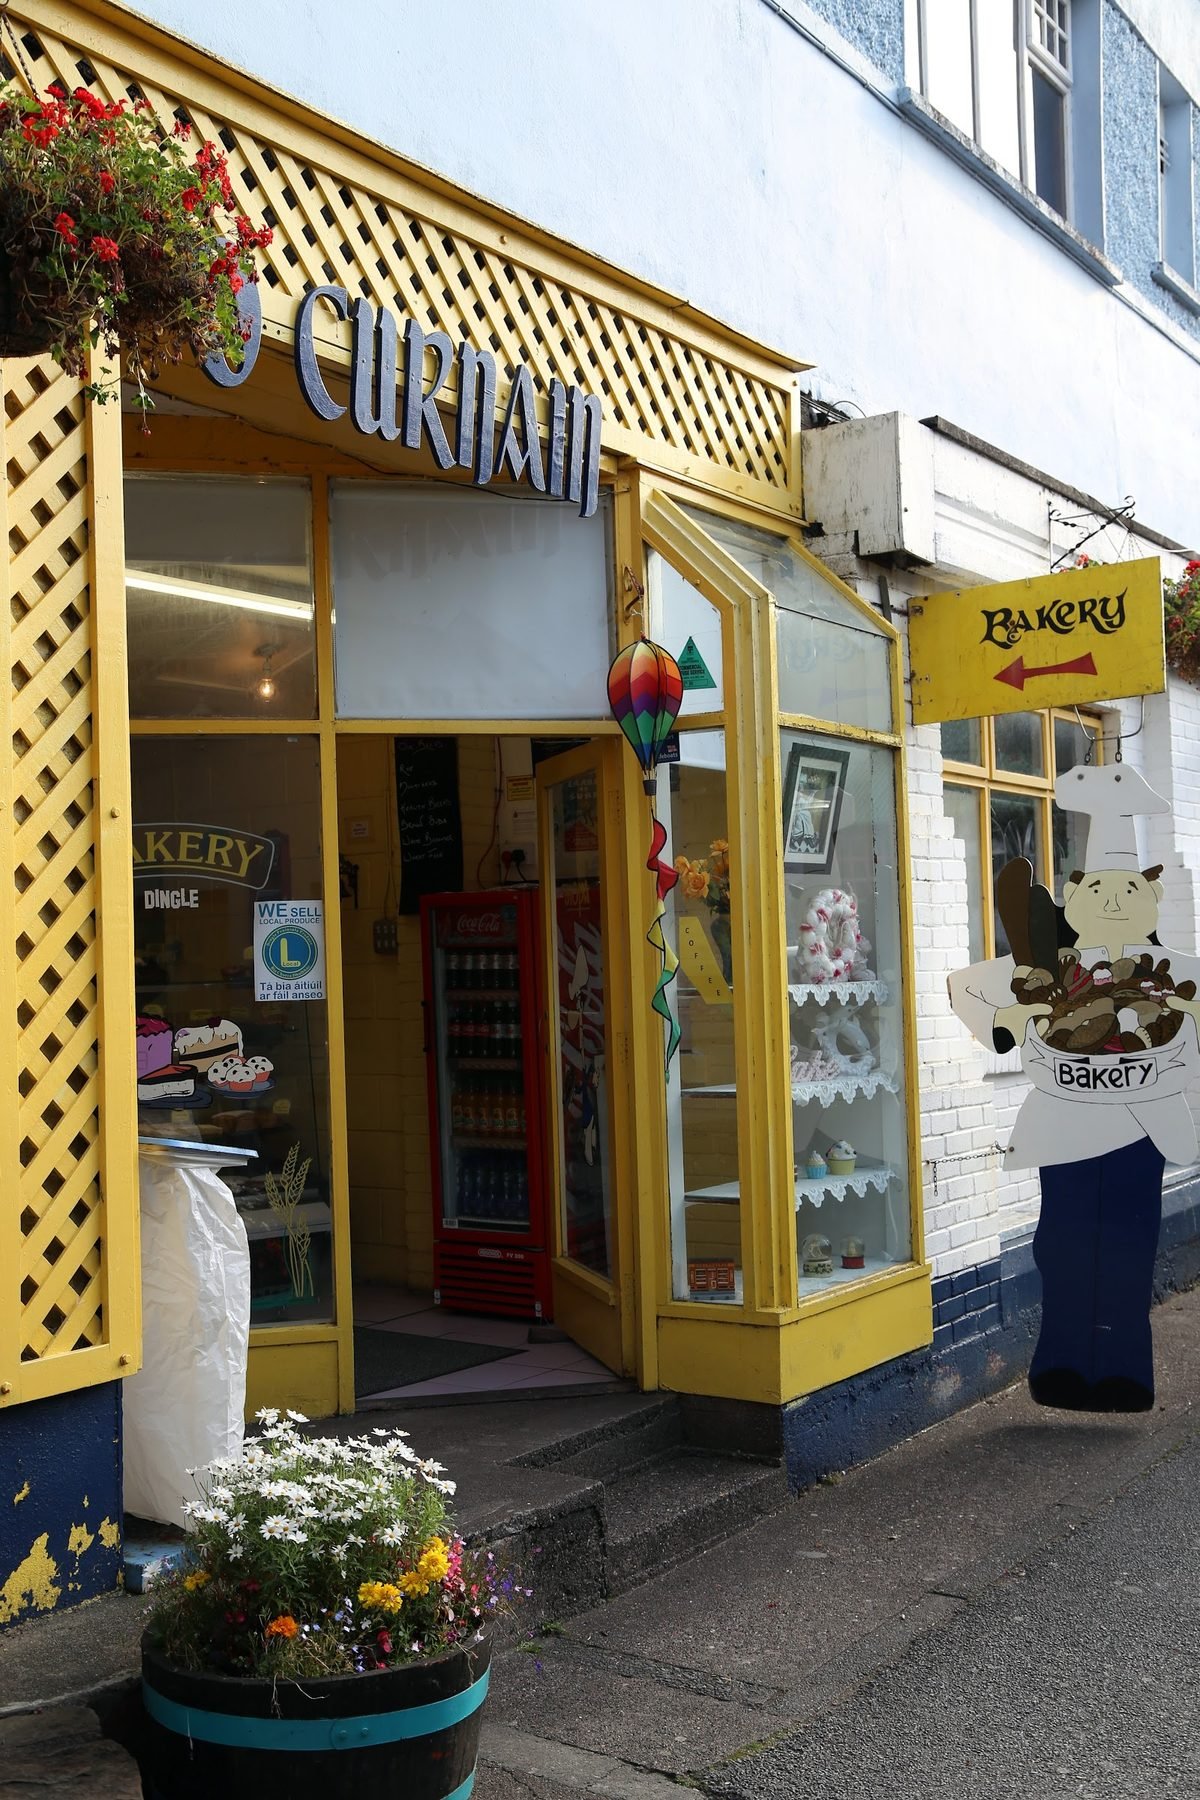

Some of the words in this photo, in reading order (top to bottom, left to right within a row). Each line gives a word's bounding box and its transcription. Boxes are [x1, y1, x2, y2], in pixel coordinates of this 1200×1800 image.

[979, 587, 1128, 650] BAKERY
[144, 888, 199, 910] DINGLE
[258, 903, 288, 918] WE
[290, 907, 322, 918] SELL
[284, 917, 320, 925] PRODUCE
[275, 981, 292, 991] bia
[273, 991, 289, 1000] fáil
[291, 991, 323, 999] anseo
[1059, 1063, 1153, 1090] Bakery
